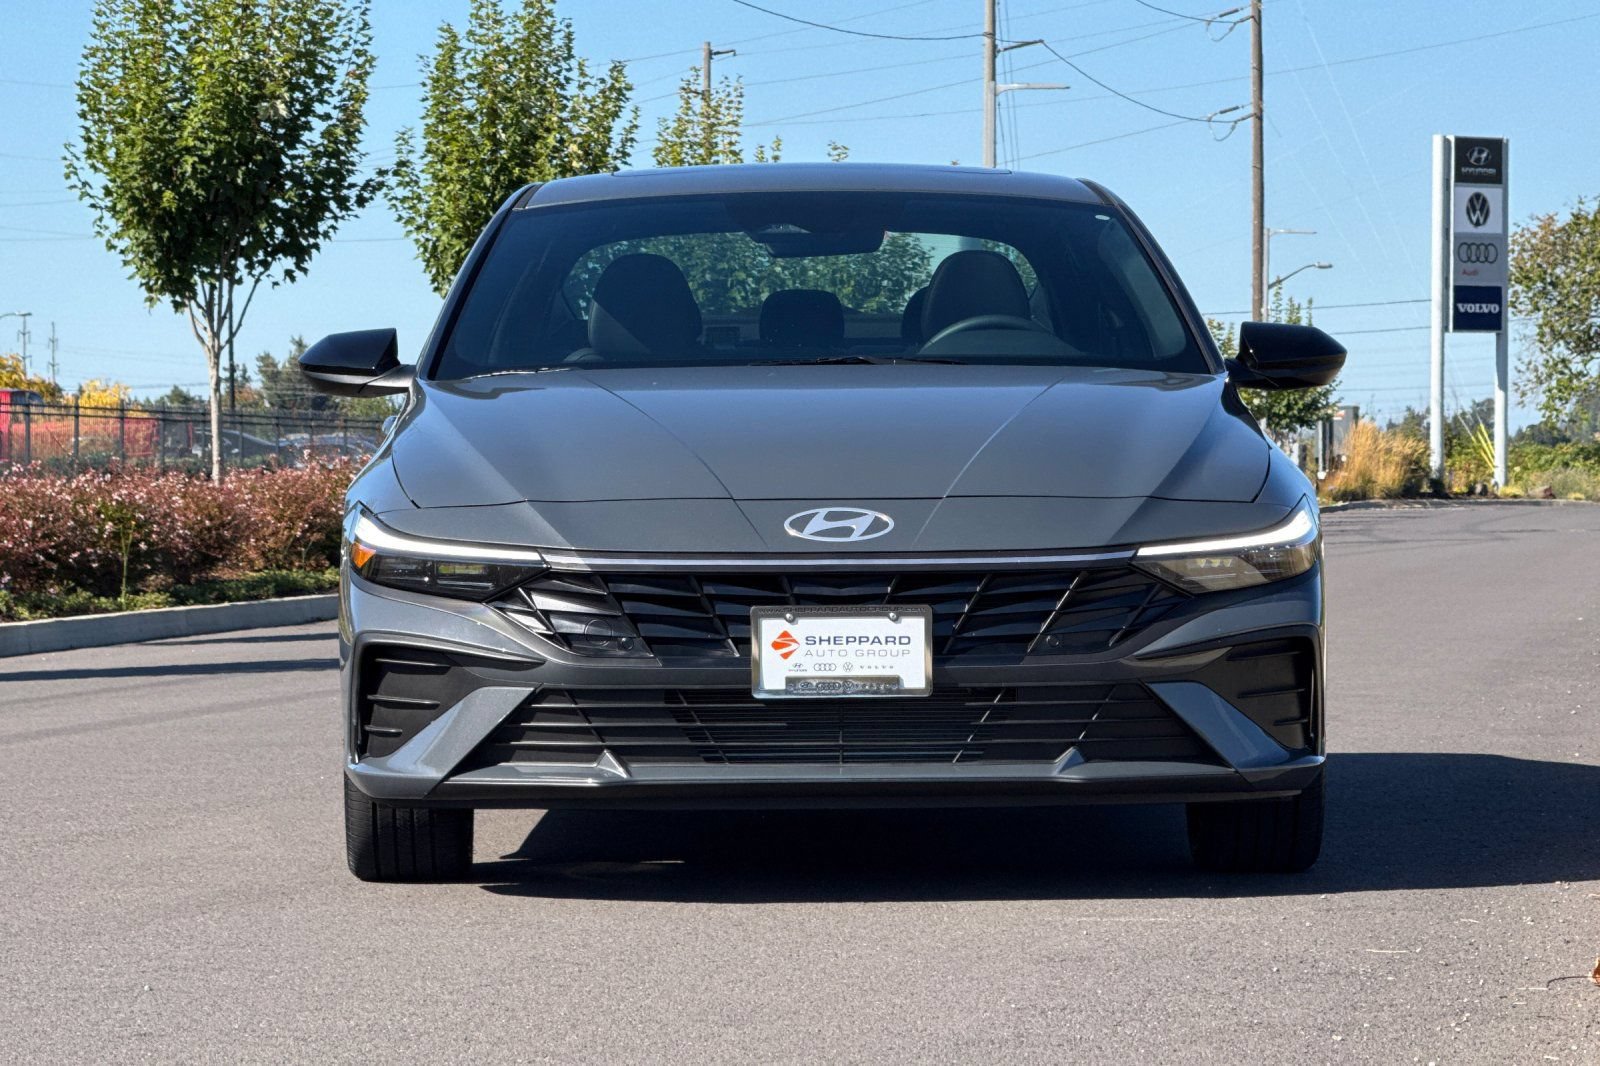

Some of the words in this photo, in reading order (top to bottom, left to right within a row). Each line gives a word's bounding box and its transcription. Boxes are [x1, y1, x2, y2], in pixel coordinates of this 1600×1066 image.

[1457, 303, 1499, 313] VOLVO
[805, 635, 911, 646] SHEPPARD
[804, 649, 847, 658] AUTO
[855, 649, 910, 658] GROUP
